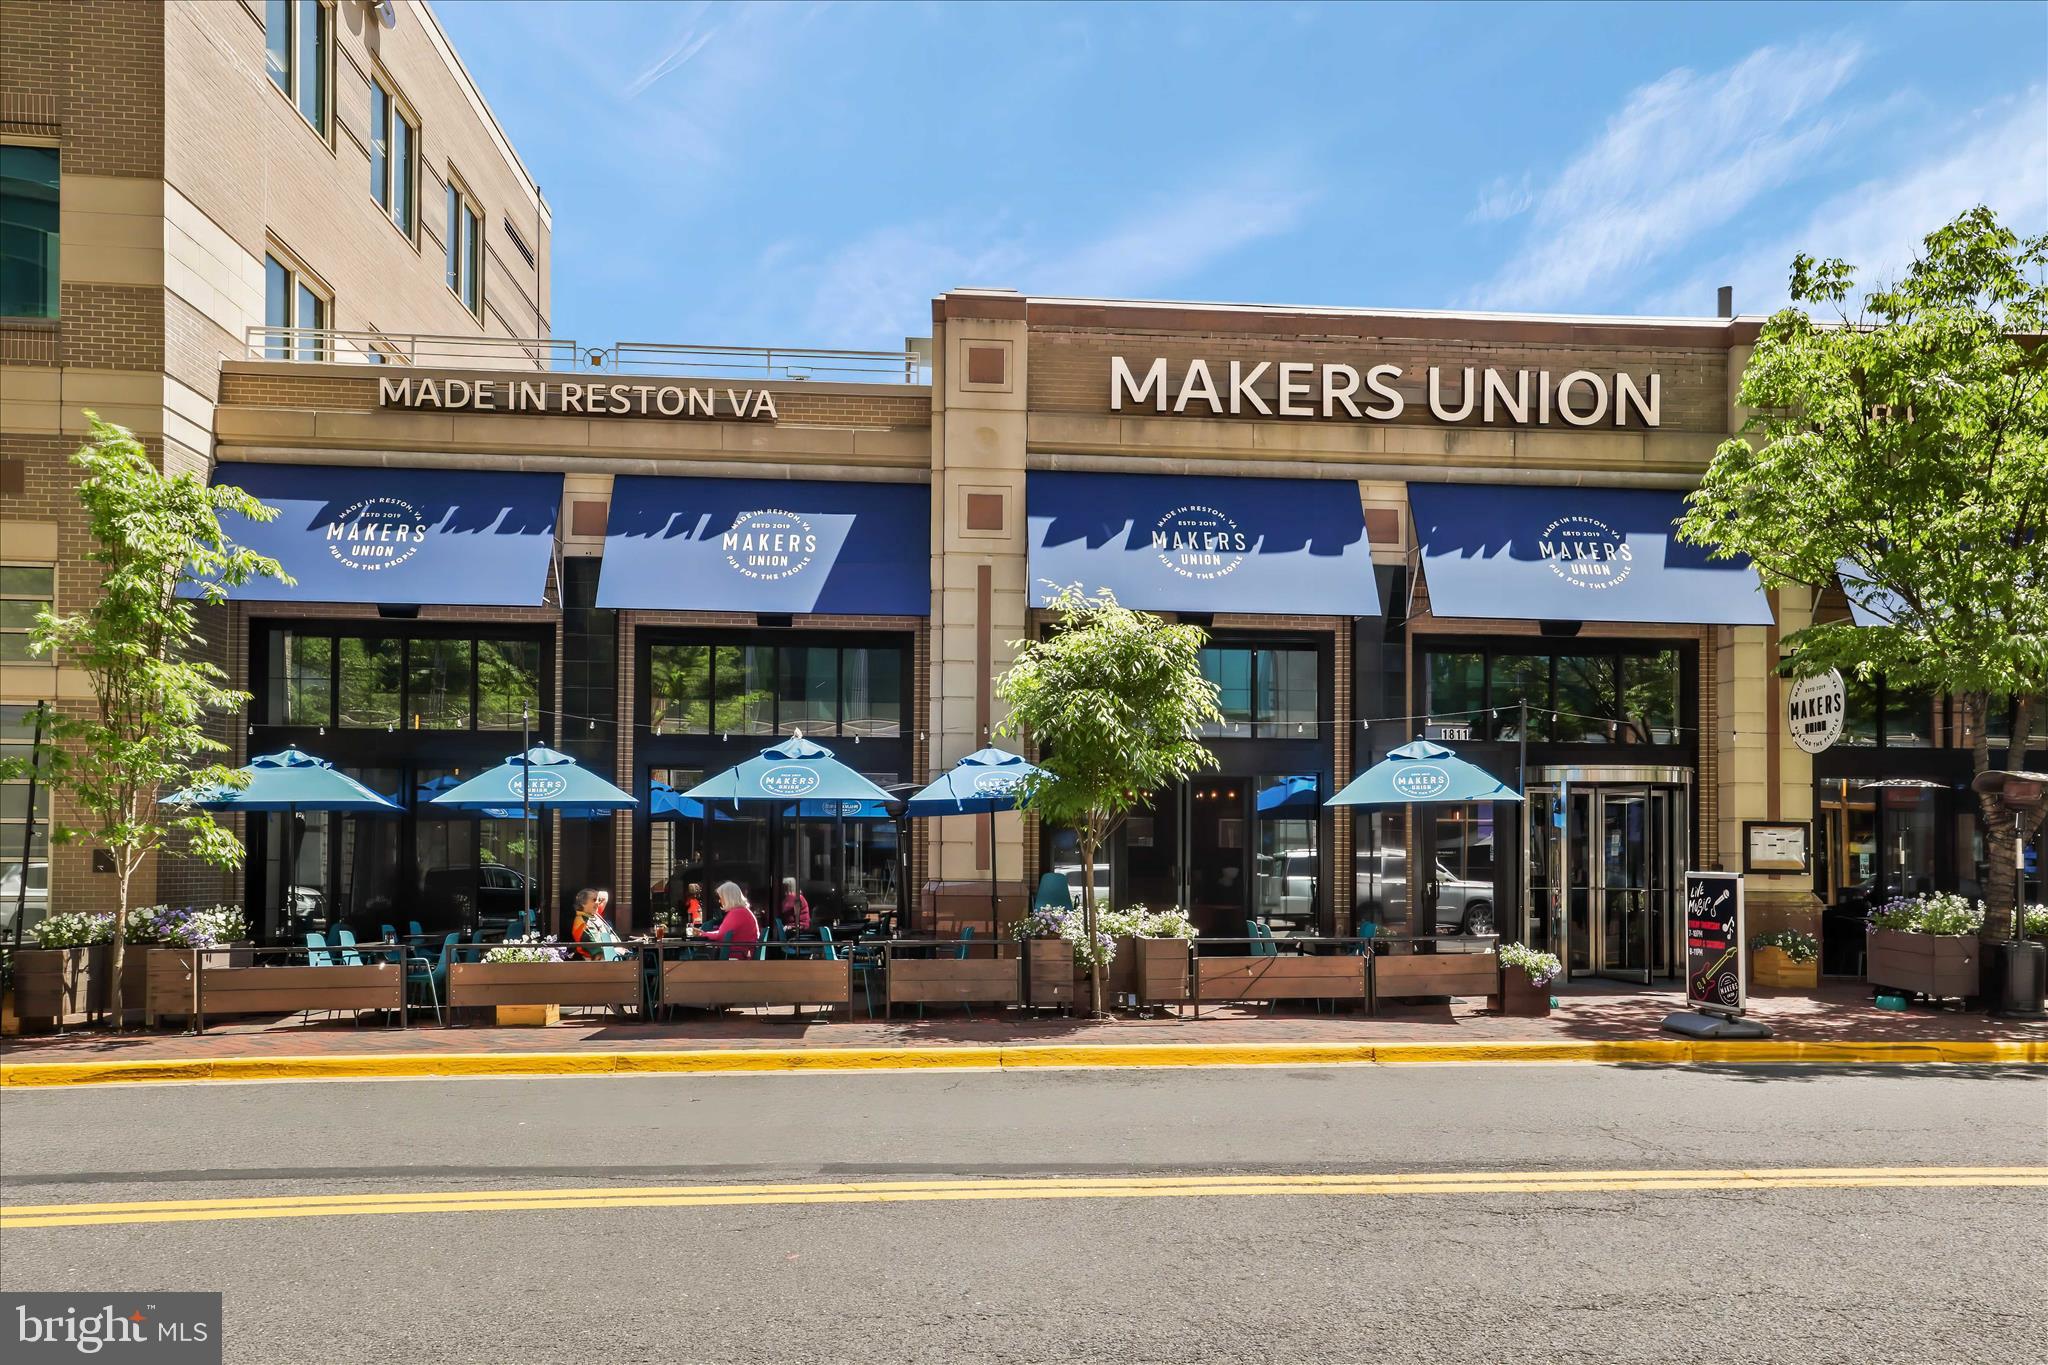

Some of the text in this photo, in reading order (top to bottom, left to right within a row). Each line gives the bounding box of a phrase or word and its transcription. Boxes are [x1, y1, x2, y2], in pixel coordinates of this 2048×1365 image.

[379, 376, 778, 419] MADE IN RESTON VA
[1111, 356, 1661, 427] MAKERS UNION
[339, 502, 362, 519] MADE
[365, 498, 375, 506] IN
[414, 512, 422, 521] VA
[731, 513, 752, 530] MADE
[802, 521, 811, 532] VA
[1157, 511, 1176, 528] MADE
[1228, 519, 1238, 529] VA
[326, 522, 427, 543] MAKERS
[1151, 530, 1246, 551] MAKERS
[1542, 521, 1560, 538] MADE
[1611, 530, 1620, 540] VA
[351, 545, 394, 557] UNION
[722, 532, 817, 552] MAKERS
[1538, 540, 1633, 561] MAKERS
[329, 545, 342, 559] PUB
[341, 558, 359, 569] FOR
[384, 546, 418, 568] PEOPLE
[726, 555, 739, 569] PUB
[739, 568, 758, 579] FOR
[782, 556, 811, 578] PEOPLE
[748, 555, 788, 567] UNION
[1158, 554, 1174, 568] PUB
[1174, 567, 1193, 579] FOR
[1217, 555, 1243, 577] PEOPLE
[1181, 554, 1221, 566] UNION
[1549, 563, 1565, 578] PUB
[1566, 577, 1585, 588] FOR
[1608, 566, 1632, 587] PEOPLE
[1571, 564, 1611, 576] UNION
[1790, 693, 1841, 720] MAKERS
[1442, 729, 1467, 740] 1811
[766, 777, 814, 785] MAKERS
[1398, 776, 1444, 785] MAKERS
